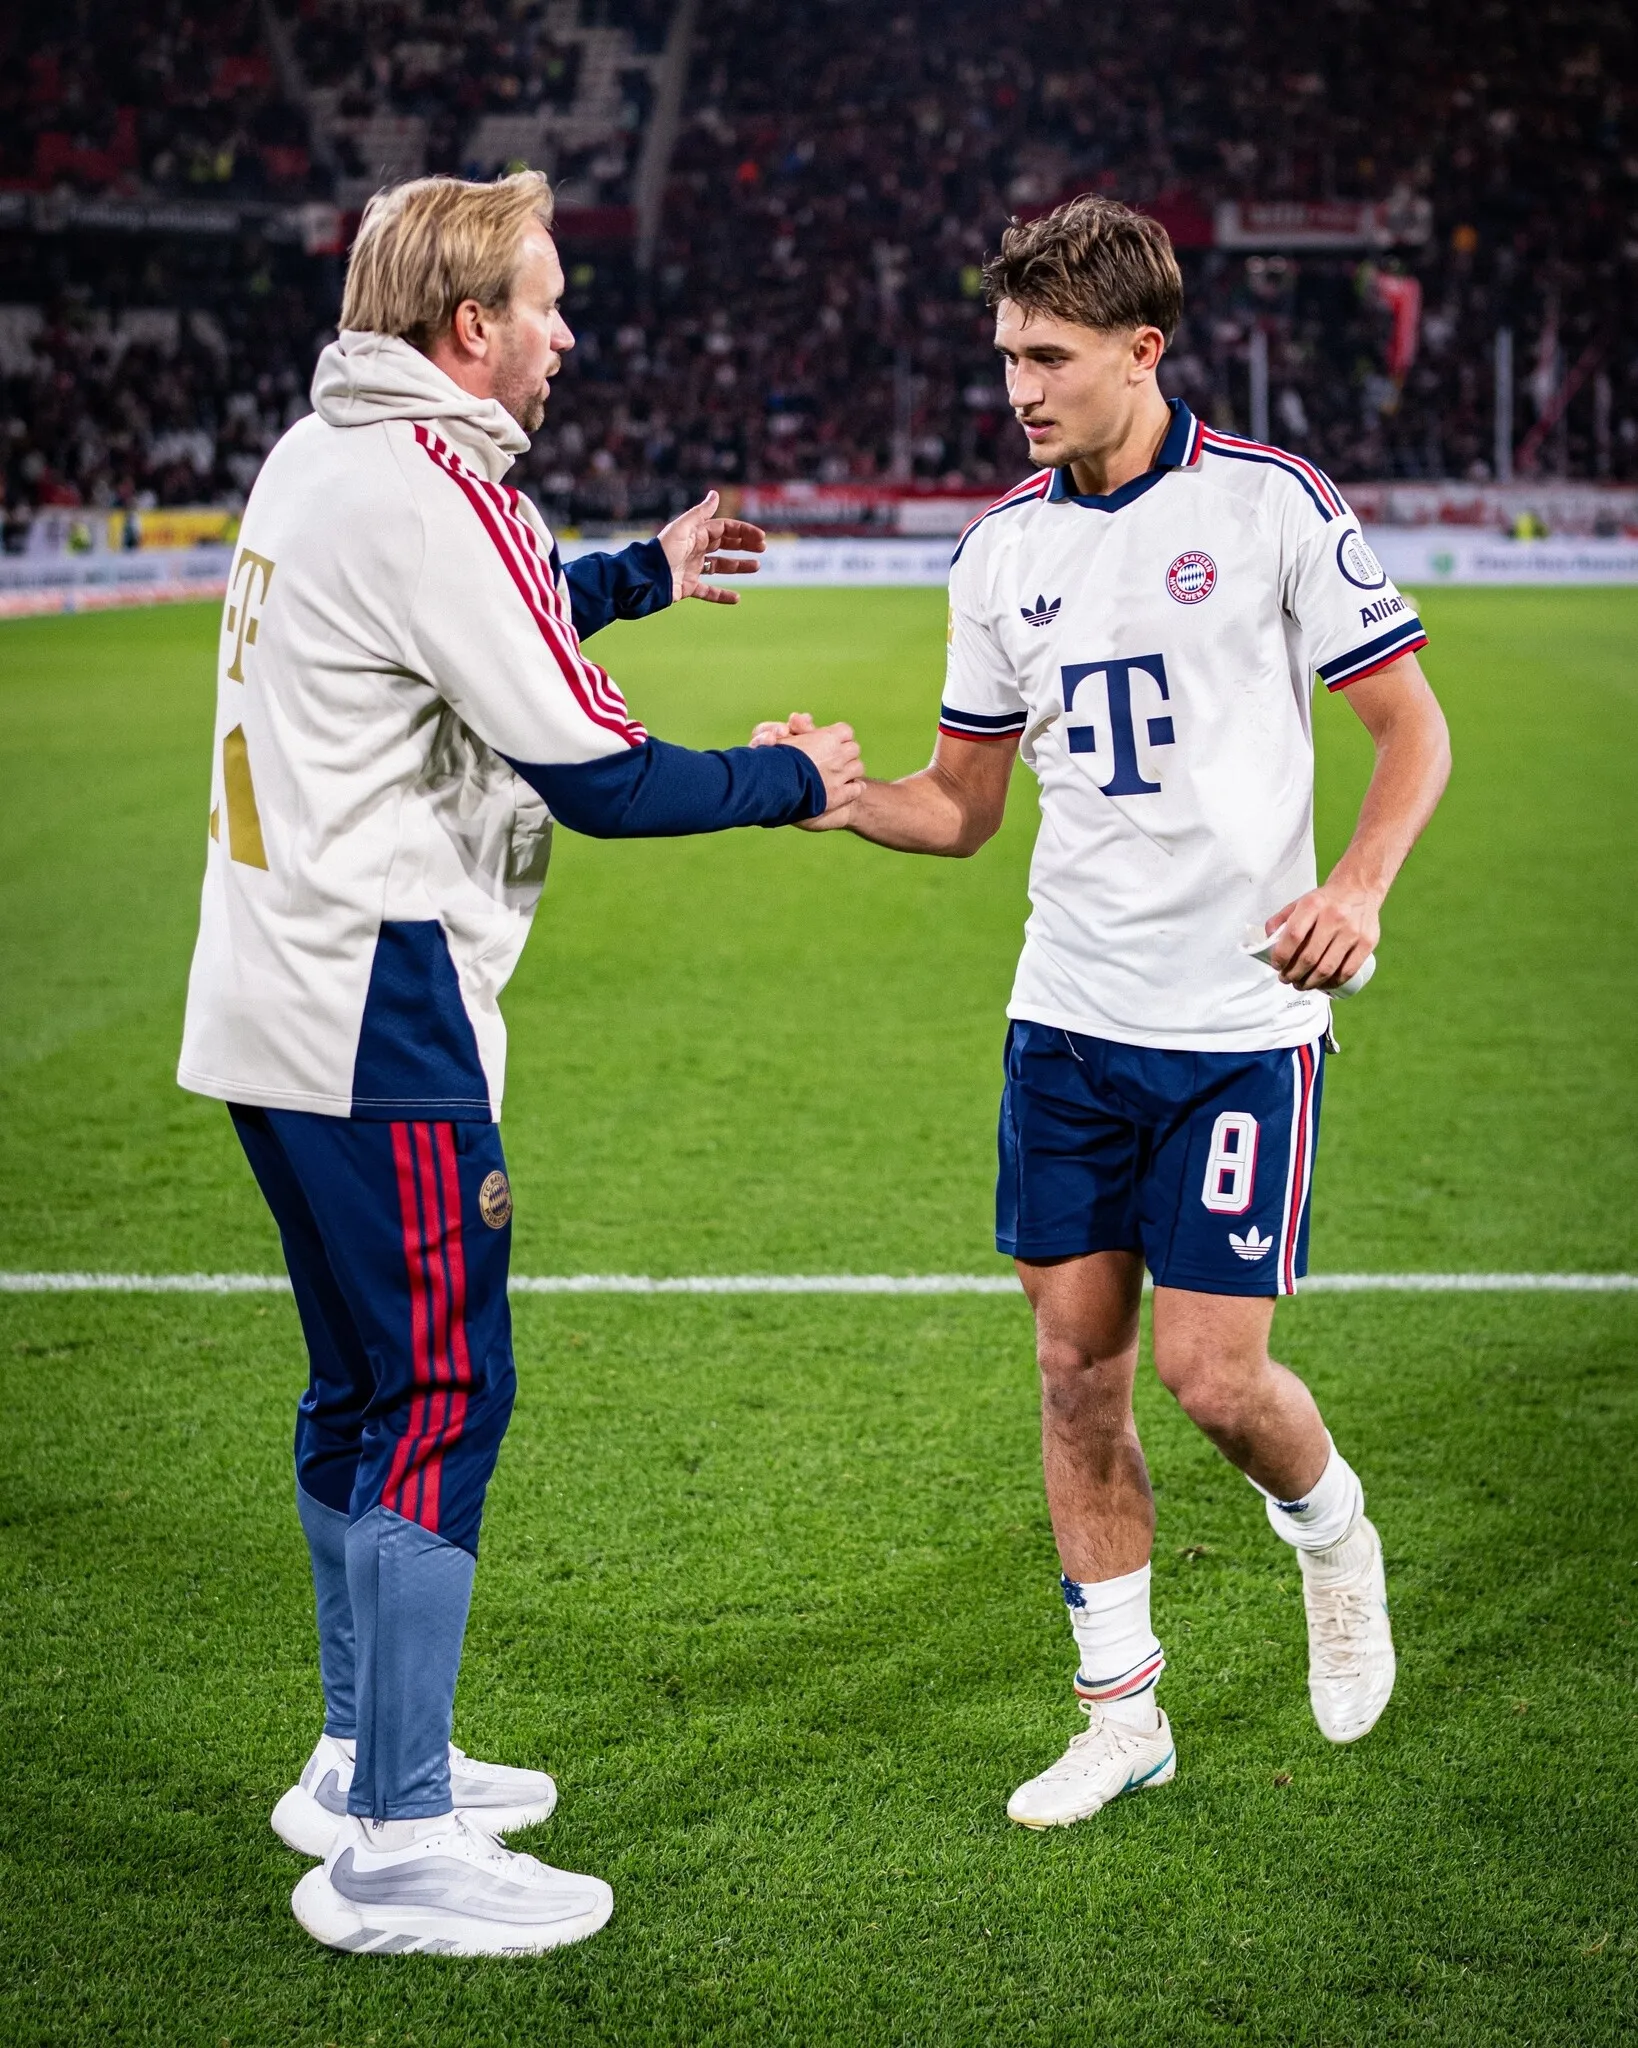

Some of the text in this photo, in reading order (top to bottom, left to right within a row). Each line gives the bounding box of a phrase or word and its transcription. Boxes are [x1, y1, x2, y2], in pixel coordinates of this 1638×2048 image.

[1173, 555, 1214, 572] FC BAYERN
[1061, 653, 1175, 797] T
[1201, 1112, 1260, 1216] 8
